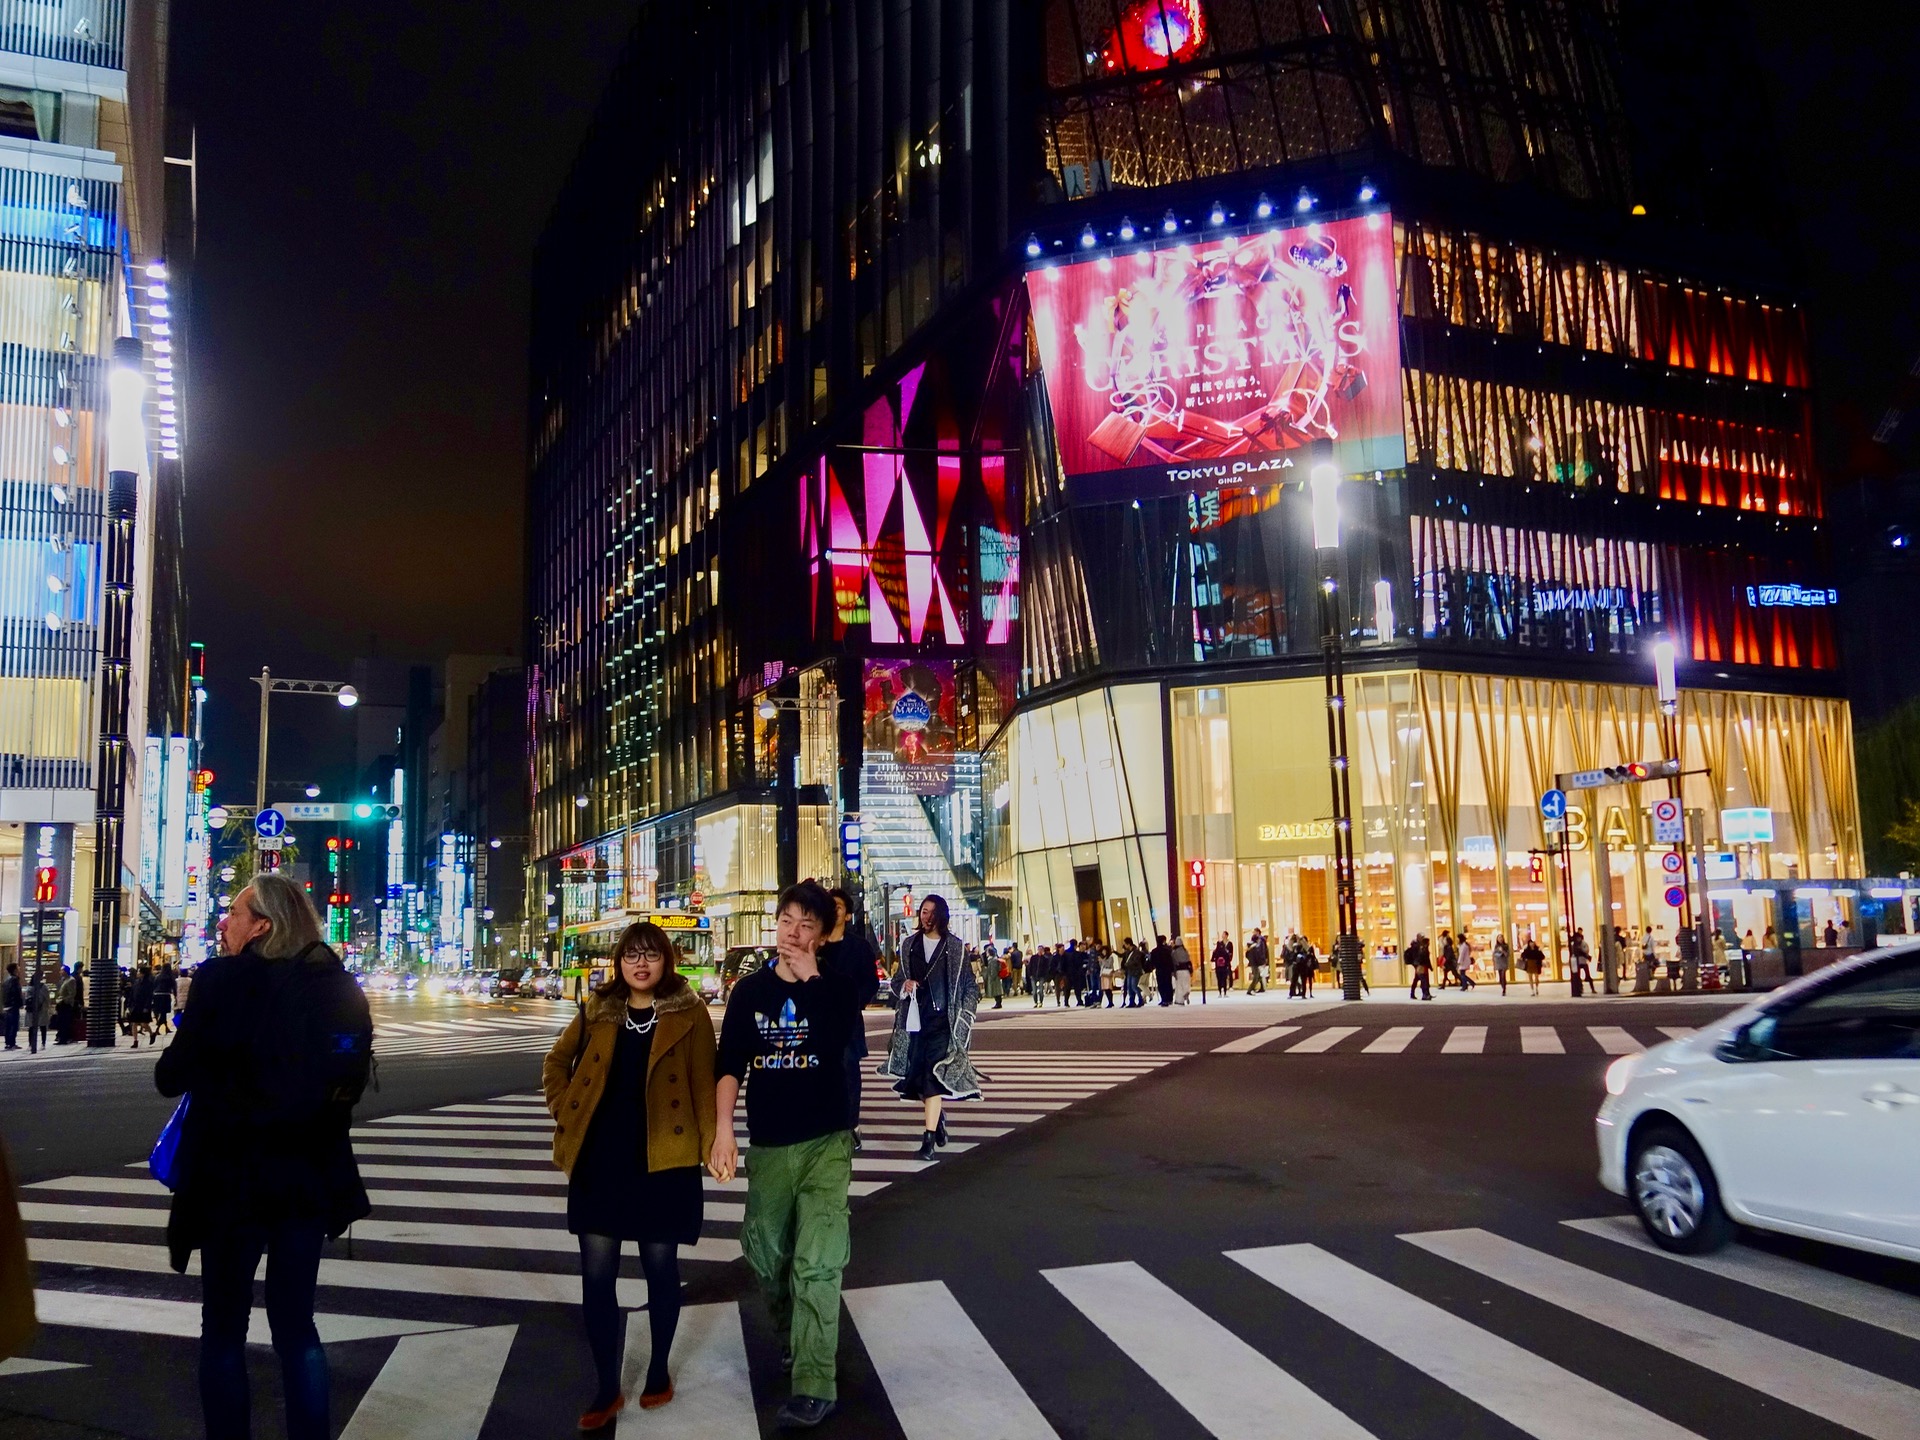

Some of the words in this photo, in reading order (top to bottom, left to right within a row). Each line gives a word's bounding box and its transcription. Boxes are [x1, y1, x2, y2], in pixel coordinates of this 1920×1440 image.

[1185, 390, 1267, 408] 新しいクリスマス。
[1167, 466, 1226, 481] TOKYU
[1232, 458, 1294, 474] PLAZA
[1218, 477, 1243, 485] GINZA
[1260, 822, 1333, 840] BALLY
[754, 1050, 819, 1069] adidas
